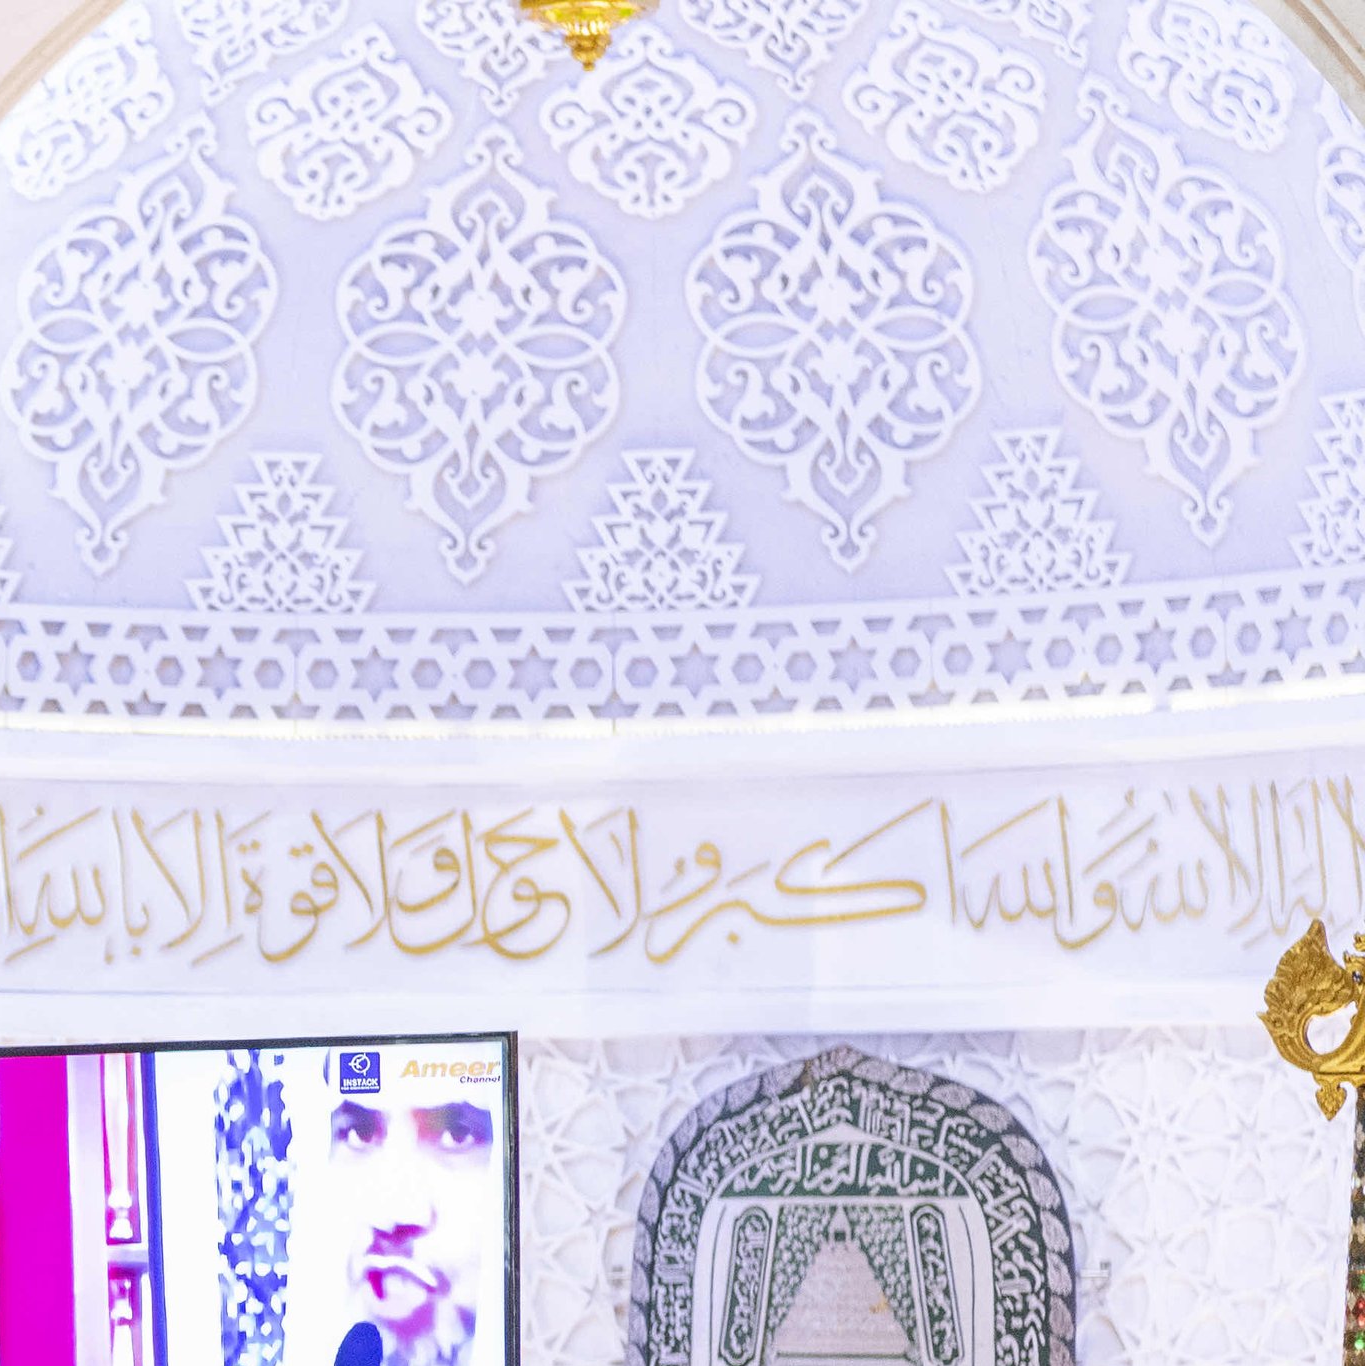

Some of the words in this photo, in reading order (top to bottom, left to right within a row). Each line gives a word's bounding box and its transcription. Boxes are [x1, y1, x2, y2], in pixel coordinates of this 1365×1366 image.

[400, 1060, 500, 1077] Ameer
[342, 1078, 379, 1087] INSTACK
[459, 1075, 501, 1084] Channel
